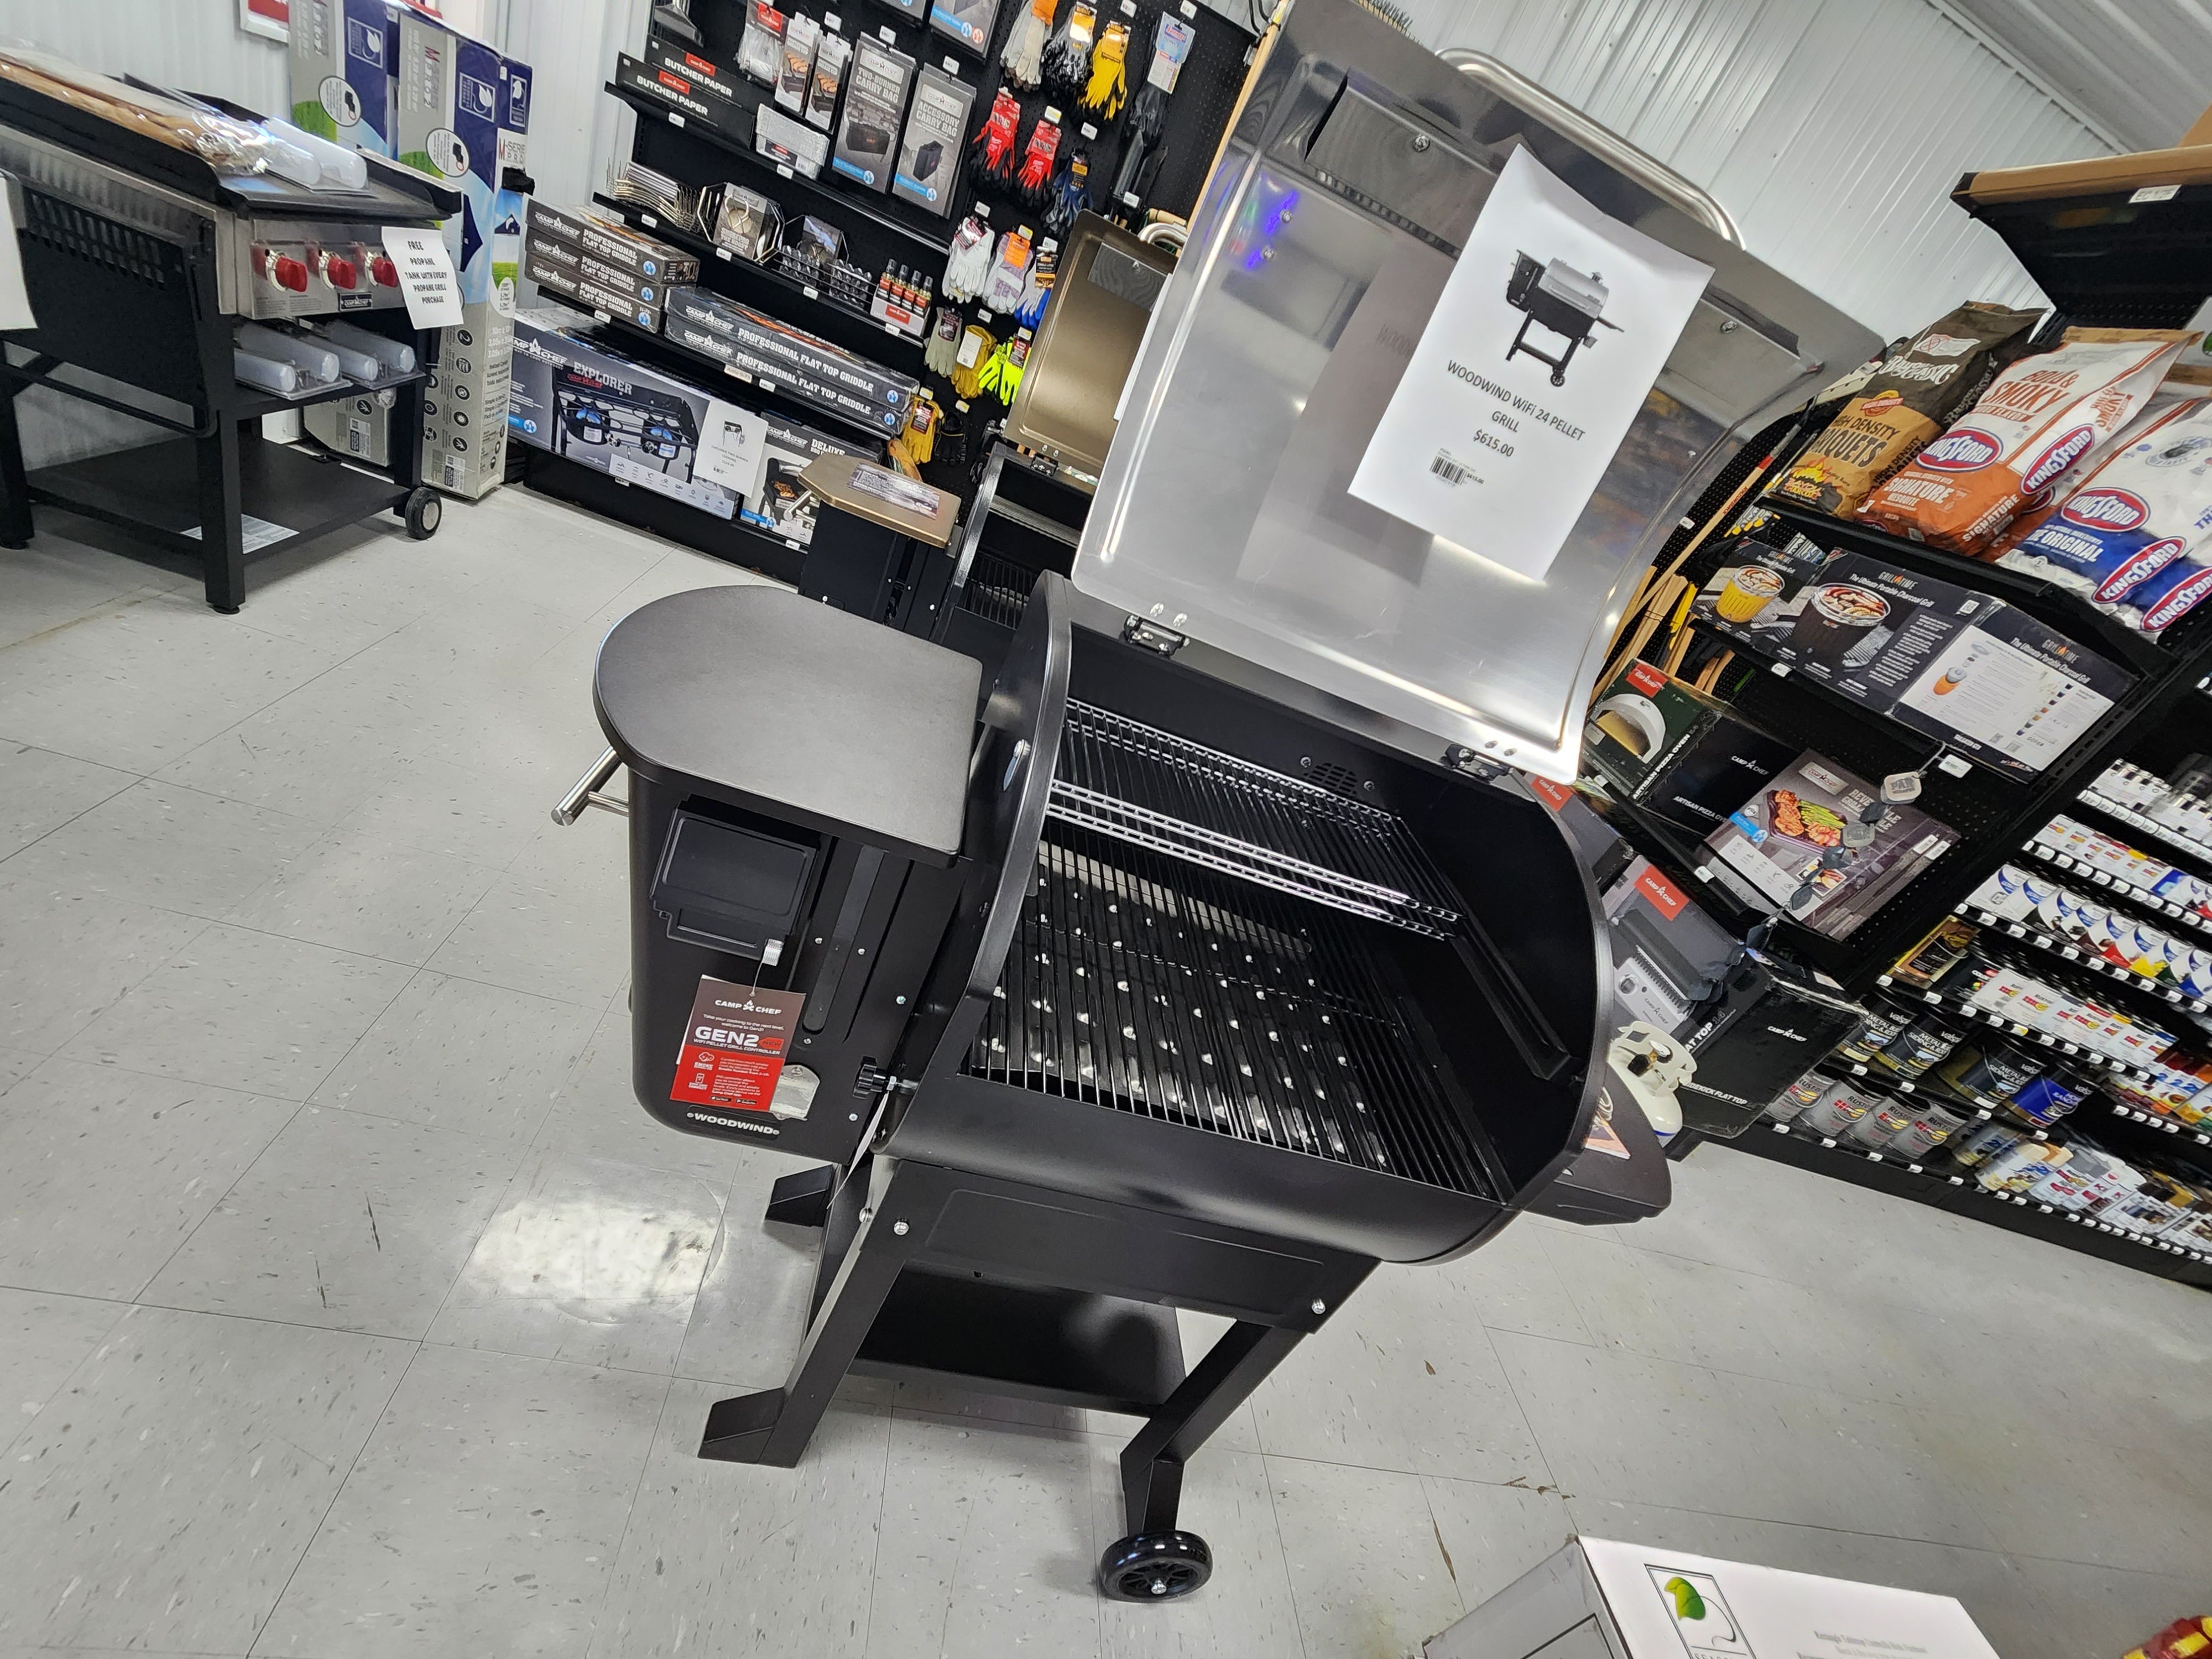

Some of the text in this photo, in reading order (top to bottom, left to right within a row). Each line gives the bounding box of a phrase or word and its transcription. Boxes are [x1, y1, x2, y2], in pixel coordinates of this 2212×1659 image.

[664, 57, 733, 98] BUTCHER PAPER
[855, 75, 880, 94] CARRY
[882, 88, 899, 104] BAG
[858, 66, 901, 95] TWO-BURNER
[637, 75, 709, 117] BUTCHER PAPER
[916, 111, 941, 129] CARRY
[941, 122, 958, 138] BAG
[917, 100, 960, 128] ACCESSORY
[407, 241, 424, 251] FREE
[582, 238, 637, 267] FLAT TOP GRIDDLE
[583, 229, 637, 260] PROFESSIONAL
[409, 257, 436, 266] PROPANE
[582, 256, 635, 287] PROFESSIONAL
[413, 284, 435, 293] PROPANE
[580, 264, 635, 293] FLAT TOP GRIDDLE
[422, 296, 444, 305] PURCHASE
[578, 290, 633, 318] FLAT TOP GRIDDLE
[580, 281, 633, 311] PROFESSIONAL
[686, 306, 707, 320] CAMP
[684, 330, 706, 345] CAMP
[540, 350, 567, 365] CHEF
[738, 327, 799, 361] PROFESSIONAL
[800, 354, 822, 371] FLAT
[822, 364, 839, 377] TOP
[839, 370, 874, 392] GRIDDLE
[573, 361, 633, 395] EXPLORER
[737, 352, 872, 415] PROFESSIONAL FLAT TOP GRIDDLE
[2020, 369, 2077, 385] BOLD
[1447, 359, 1586, 441] WOODWIND WiFi 24 PELLET
[1981, 380, 2070, 414] SMOKY
[1491, 410, 1520, 433] GRILL
[1852, 418, 1902, 441] DENSITY
[810, 447, 820, 455] BBQ
[1473, 429, 1515, 457] $615.00
[1892, 435, 1921, 467] DENSITY
[2026, 430, 2093, 490] KINGSFORD
[1467, 473, 1485, 484] $615.00
[1884, 477, 1955, 505] SIGNATURE
[1887, 493, 1921, 507] MESQUITE
[2067, 495, 2141, 526] KINGSFORD
[1963, 494, 2020, 542] SIGNATURE
[2043, 531, 2105, 563] ORIGINAL
[1878, 571, 1919, 590] GRILL TIME
[2101, 542, 2179, 599] KINGSFORD
[1849, 573, 1936, 608] The Ultimate Portable Charcoal Grill
[2148, 571, 2212, 629] KINGSFOR
[2010, 637, 2091, 684] The Ultimate Portable Charcoal Grill
[1632, 733, 1691, 800] ARTISAN PIZZA OVEN
[1731, 754, 1770, 777] CAMP CHEF
[1539, 779, 1563, 801] CAMP CHEF
[1673, 795, 1715, 818] ARTISAN PIZZA
[1645, 877, 1677, 907] CAMP CHEF
[1971, 969, 1989, 981] COLO
[714, 999, 782, 1015] CAMP CHEF
[1645, 998, 1669, 1025] CAMP CHEF
[1695, 1021, 1713, 1040] TOP
[1767, 1025, 1785, 1036] CAMP
[1867, 1014, 1890, 1029] METAL
[695, 1026, 760, 1047] GEN2
[706, 1040, 728, 1048] PELLET
[743, 1046, 781, 1055] CONTROLLER
[1908, 1032, 1932, 1049] SIDING
[1919, 1032, 1942, 1047] METAL
[1989, 1064, 2011, 1080] SIDING
[1999, 1065, 2022, 1078] METAL
[1687, 1082, 1749, 1105] IDEKICK FLAT TOP
[693, 1113, 775, 1134] WOODWIND
